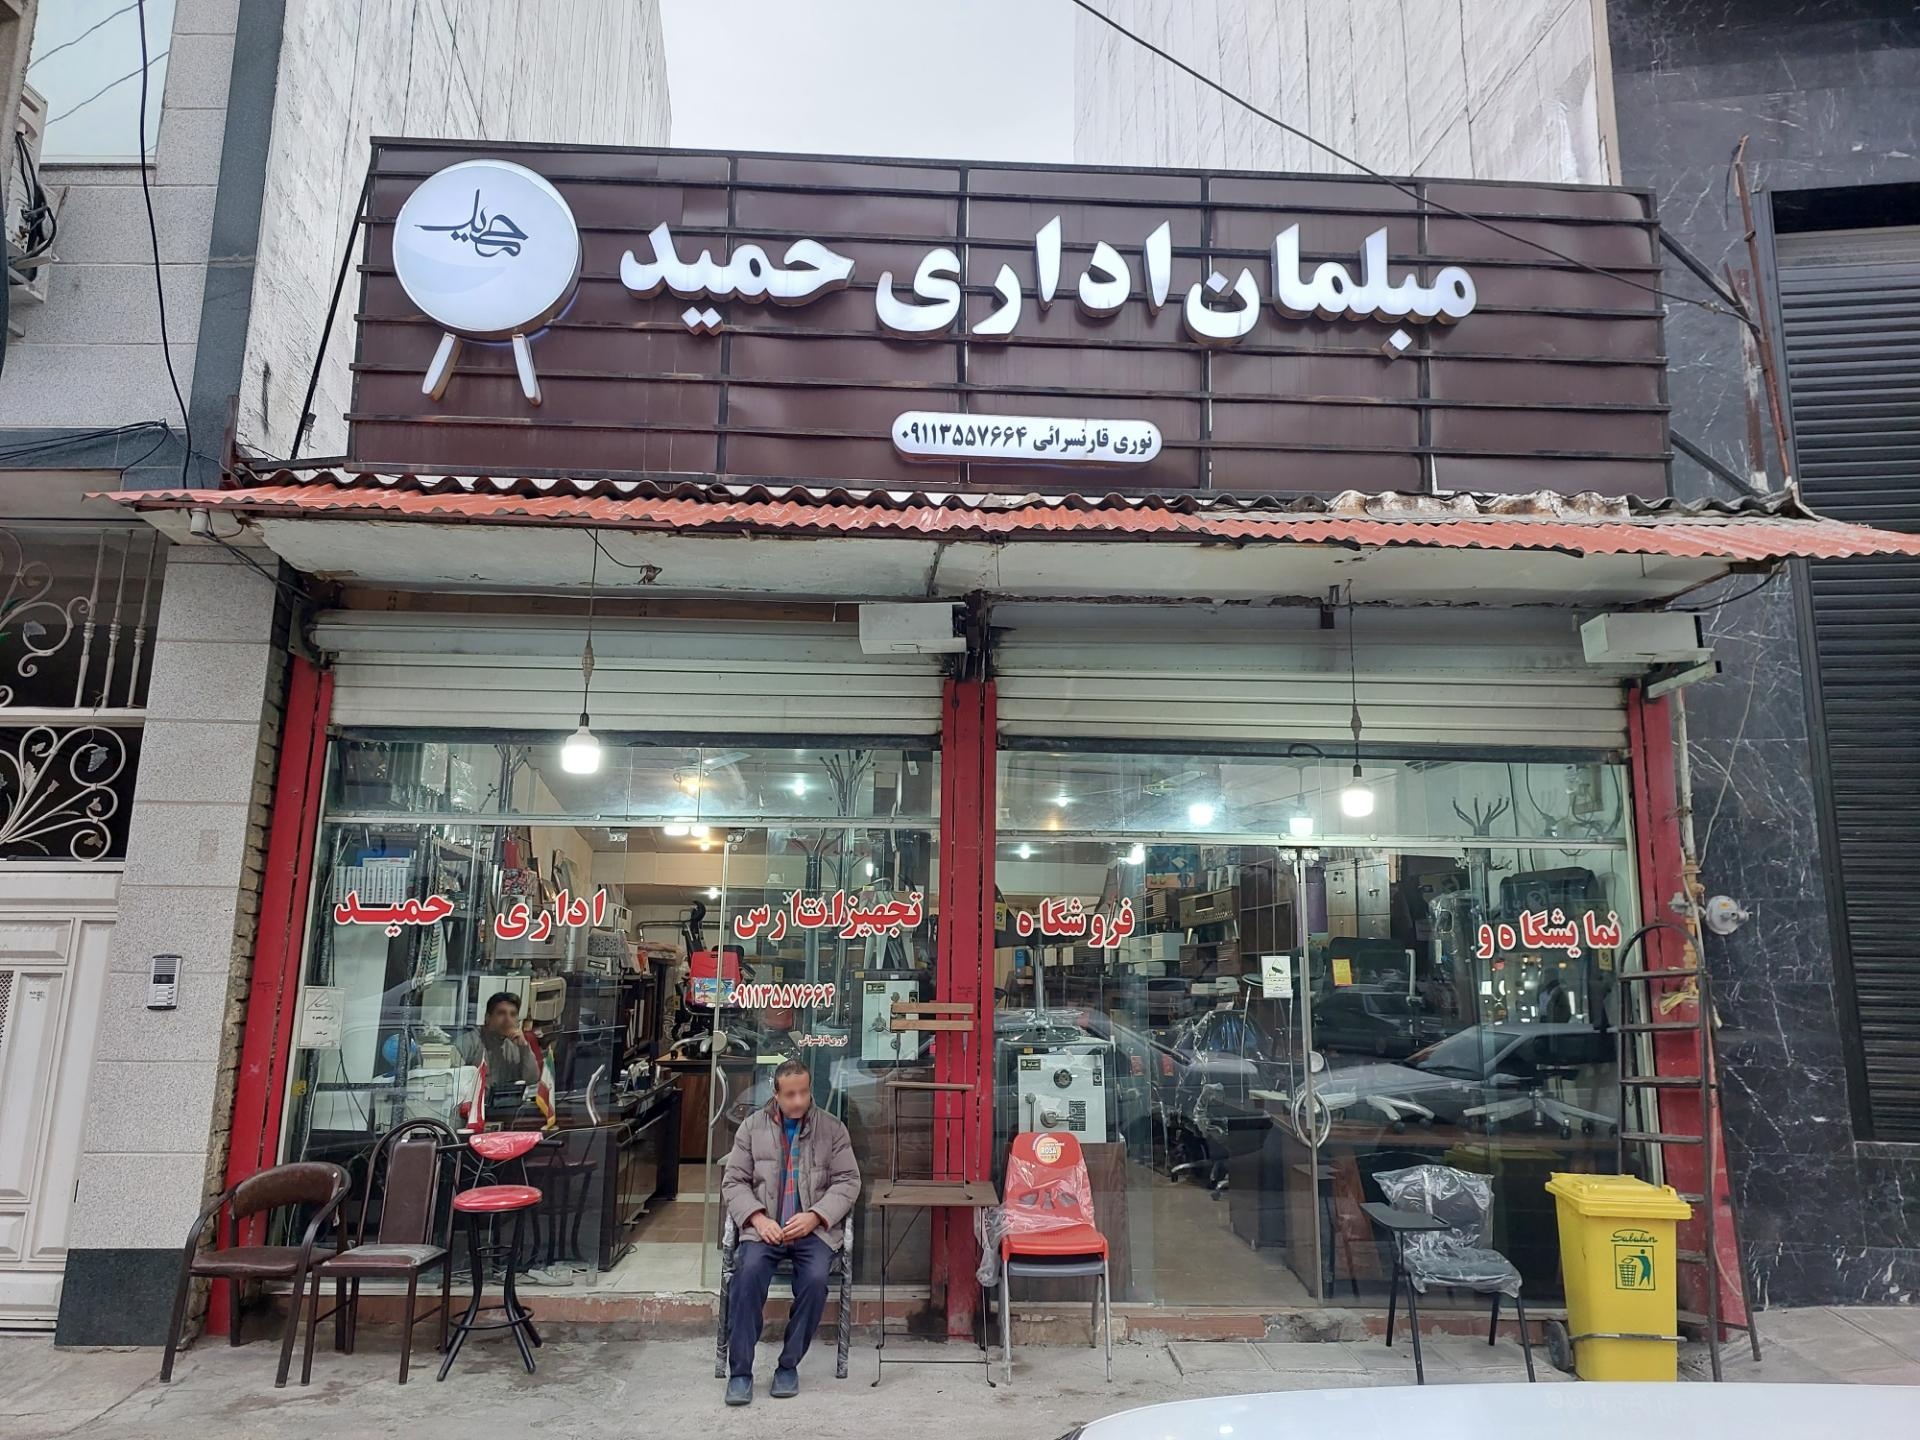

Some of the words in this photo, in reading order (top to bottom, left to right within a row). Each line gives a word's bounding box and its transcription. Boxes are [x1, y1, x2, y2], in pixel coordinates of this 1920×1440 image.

[619, 221, 855, 336] حمید
[876, 215, 1172, 336] اداری
[1183, 222, 1478, 360] مبلمان
[901, 421, 1028, 447] ۰۹۱۱۳۵۵۷۶۶۴
[1113, 429, 1153, 455] نوری
[334, 890, 455, 938] حمید
[494, 888, 607, 941] اداری
[796, 889, 924, 939] تجهیزات
[728, 983, 836, 1009] ۰۹۱۱۳۵۵۷۶۶۴
